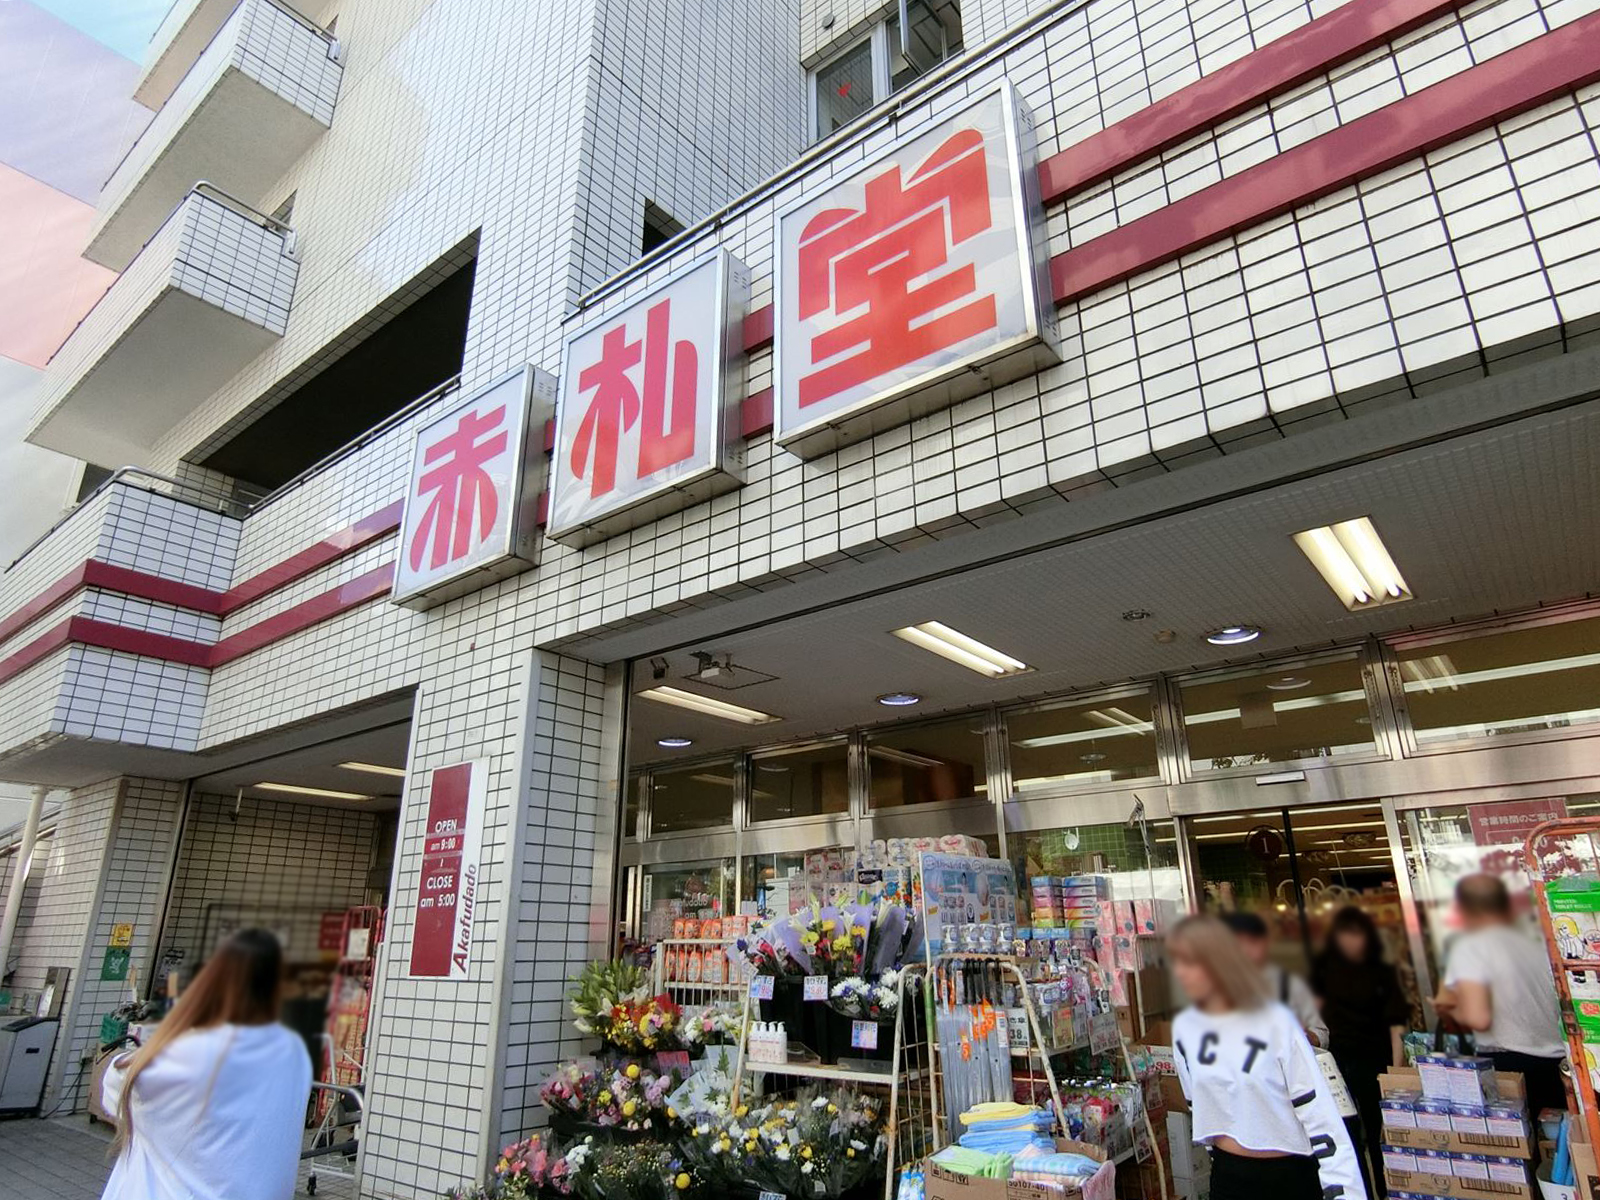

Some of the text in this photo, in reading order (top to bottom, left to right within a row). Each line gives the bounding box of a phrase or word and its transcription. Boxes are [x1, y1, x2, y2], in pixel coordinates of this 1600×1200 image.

[409, 128, 999, 574] 赤札堂
[435, 819, 457, 833] OPEN
[430, 842, 440, 851] am
[426, 874, 453, 889] CLOSE
[420, 893, 455, 907] am 5:00
[453, 863, 477, 973] Akafudado
